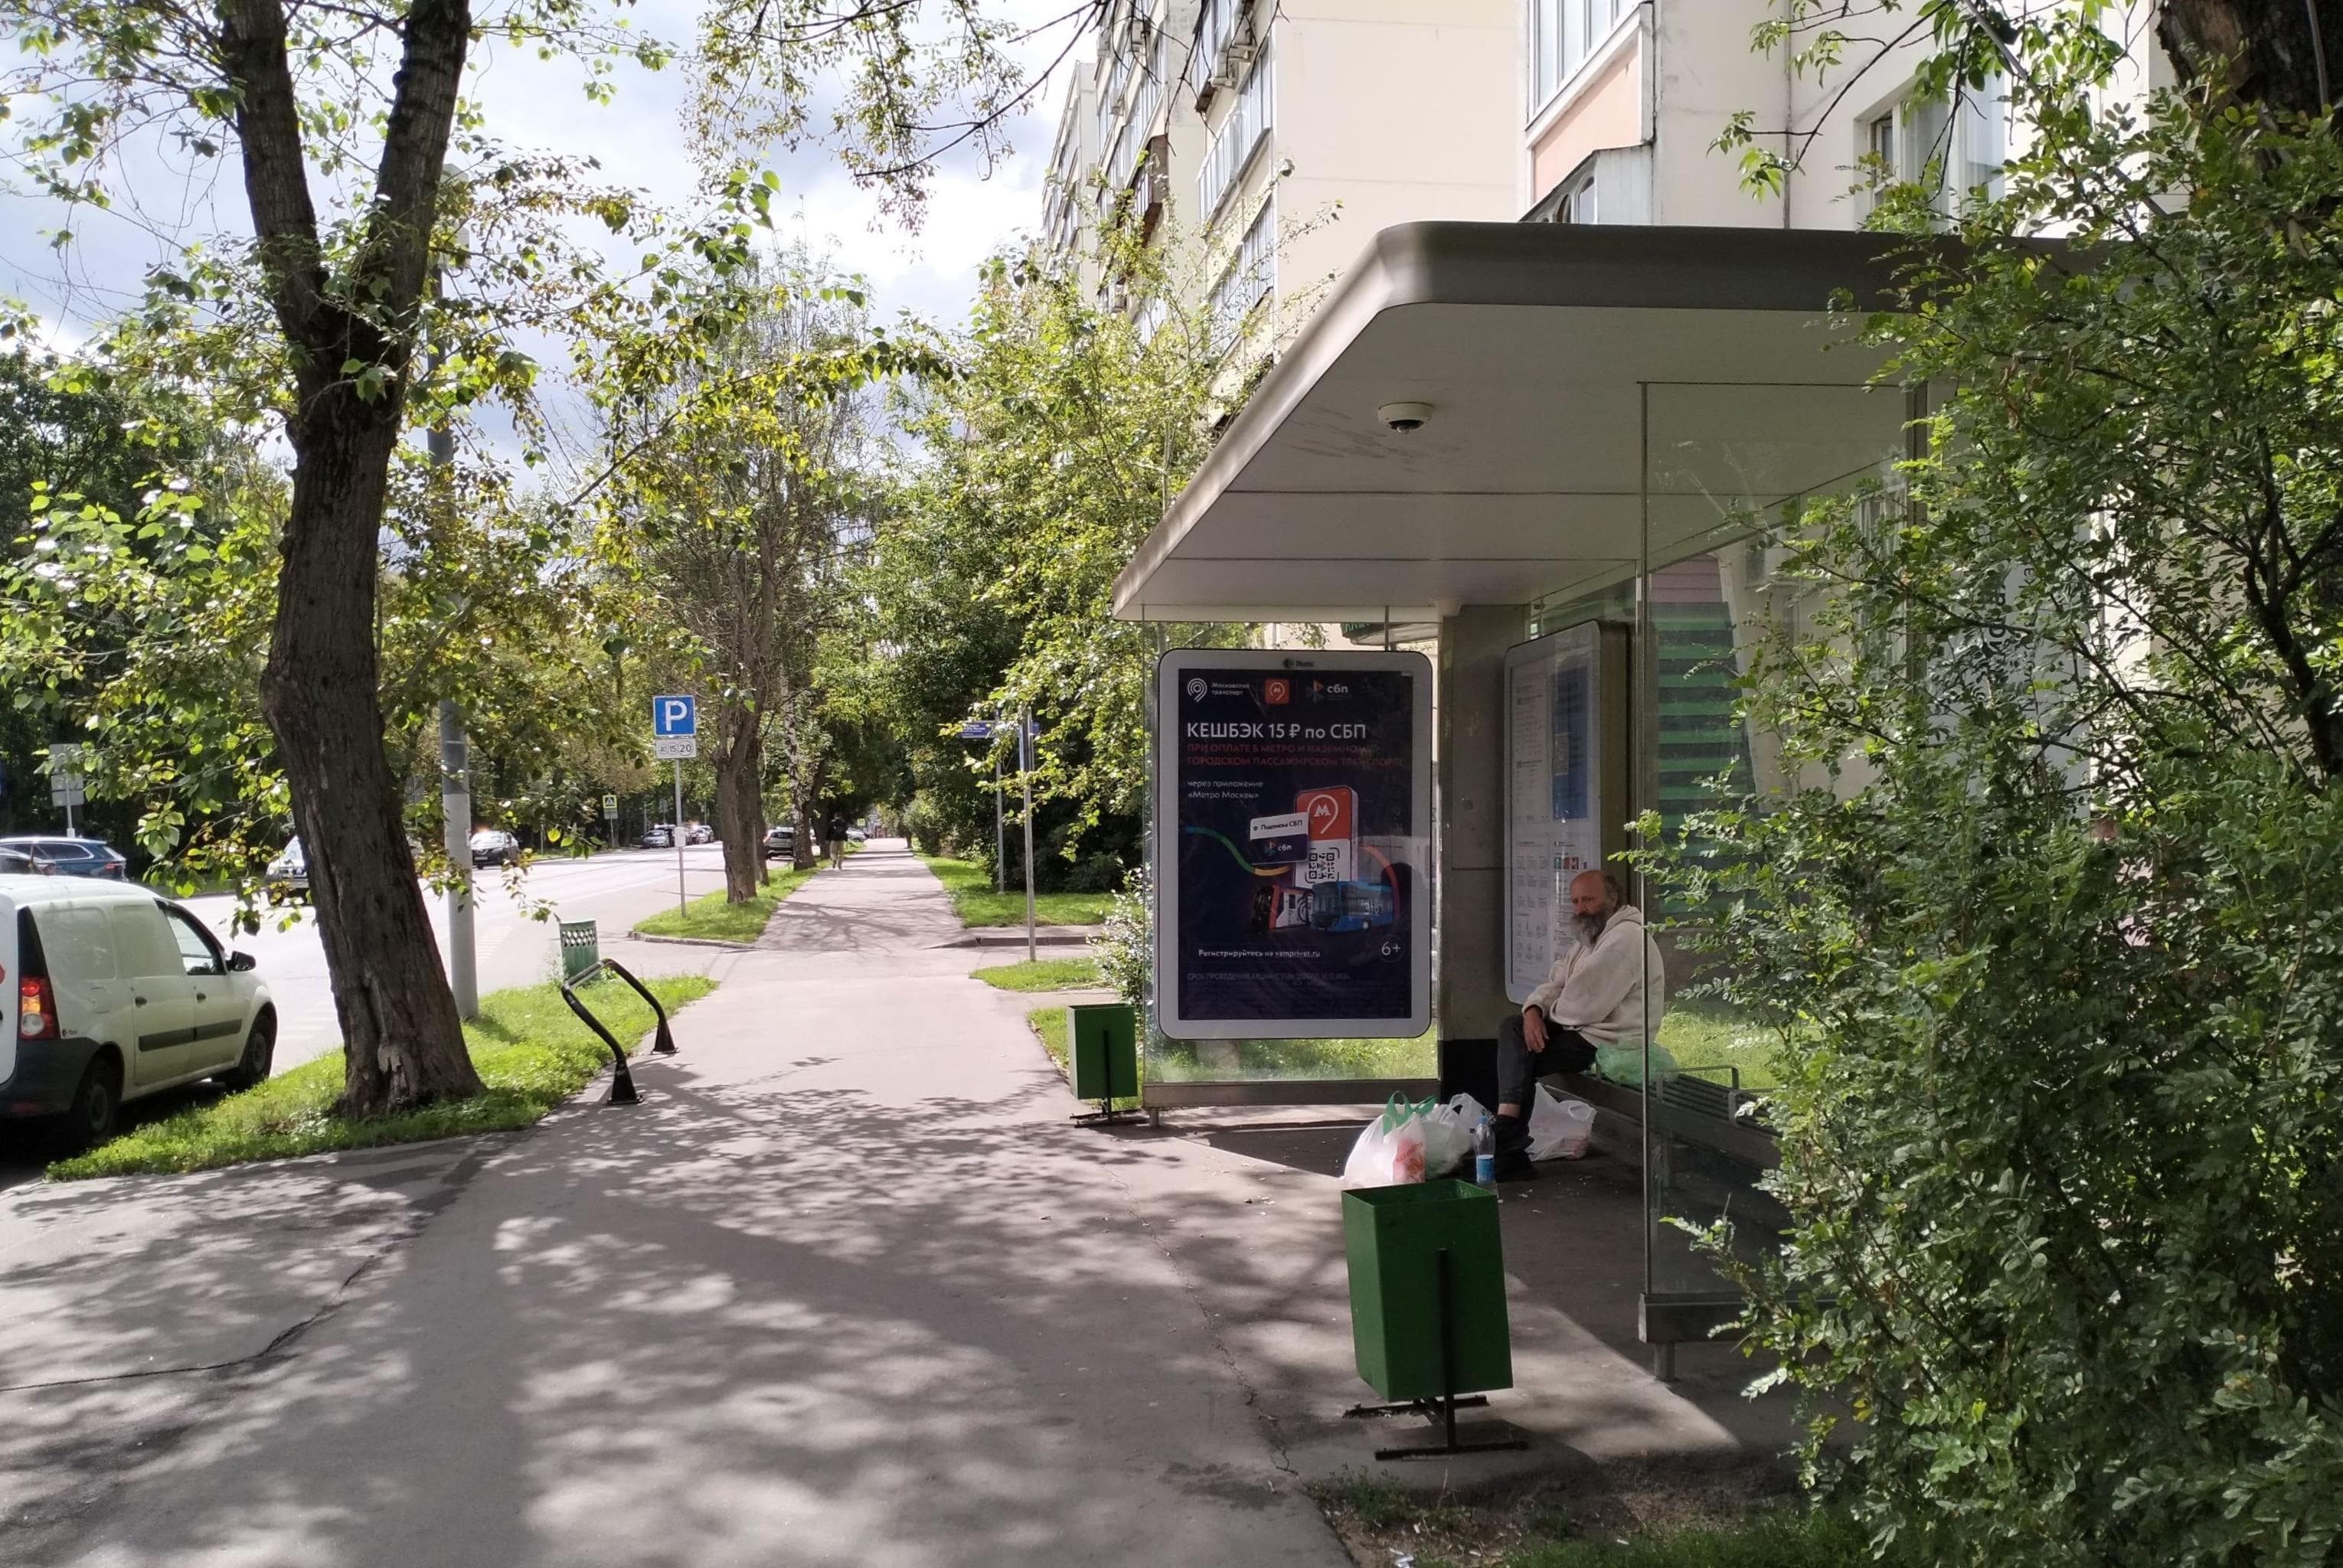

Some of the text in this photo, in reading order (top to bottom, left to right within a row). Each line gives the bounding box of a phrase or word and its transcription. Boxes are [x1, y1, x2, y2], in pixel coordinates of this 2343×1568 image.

[1327, 683, 1348, 693] сбп
[665, 701, 688, 731] P
[1188, 722, 1263, 738] КЕШБЭК
[1269, 723, 1285, 738] 15
[1305, 728, 1325, 739] по
[1330, 724, 1366, 739] СБП
[680, 744, 691, 753] 20
[1188, 743, 1207, 753] ПРИ
[1209, 744, 1250, 753] ОПЛАТЕ
[1260, 745, 1296, 753] МЕТРО
[1188, 756, 1250, 766] ГОРОДСКОМ
[1253, 757, 1338, 766] ПАССАЖИРСКОМ
[1198, 949, 1262, 958] Регистрируйтесь
[1381, 942, 1401, 956] 6+
